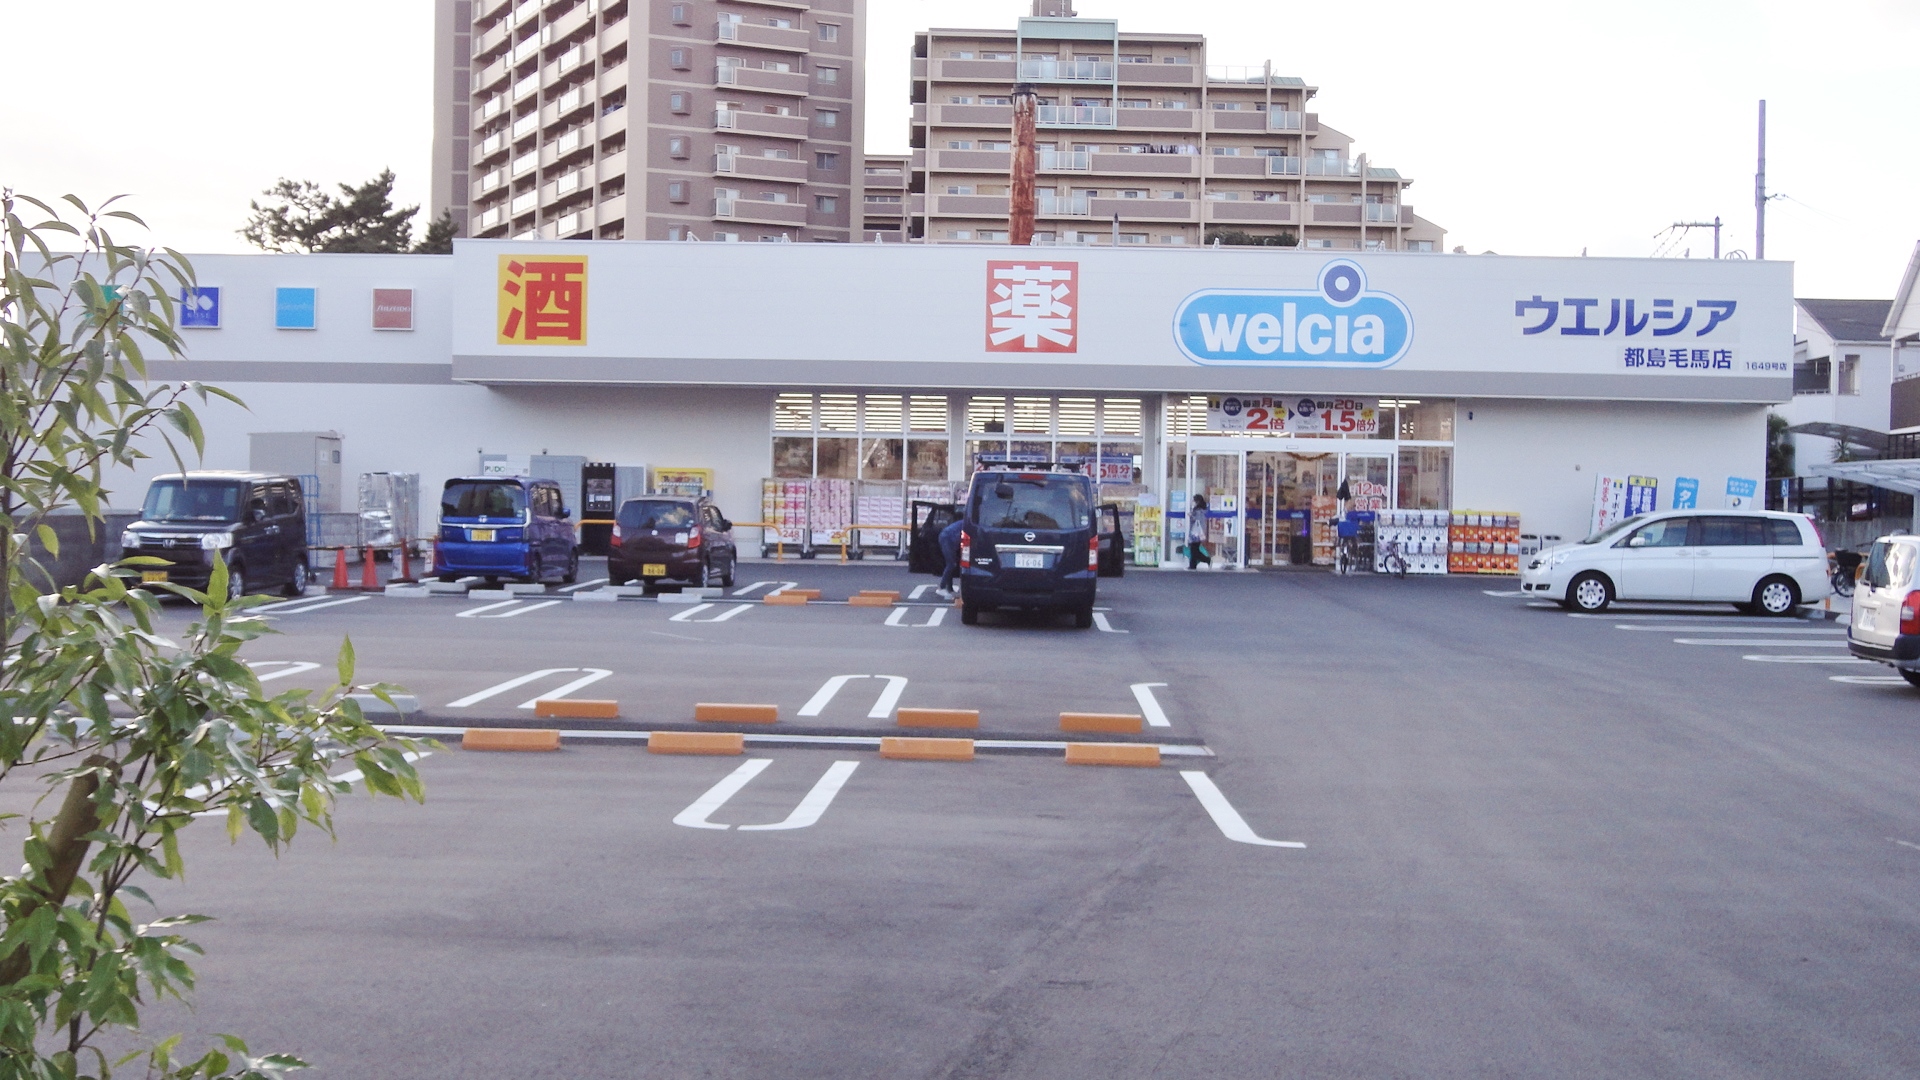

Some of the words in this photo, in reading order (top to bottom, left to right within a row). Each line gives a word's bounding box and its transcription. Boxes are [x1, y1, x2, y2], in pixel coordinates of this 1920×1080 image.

[502, 260, 585, 341] 酒
[989, 265, 1074, 349] 薬
[1197, 265, 1386, 356] welcia
[1514, 295, 1738, 337] ウエルシア
[1624, 347, 1733, 369] 都島毛馬店
[1745, 361, 1788, 371] 1649号店
[1246, 408, 1285, 430] 2倍
[1321, 409, 1376, 432] 1.5倍分
[782, 530, 800, 538] 248
[880, 532, 896, 540] 193
